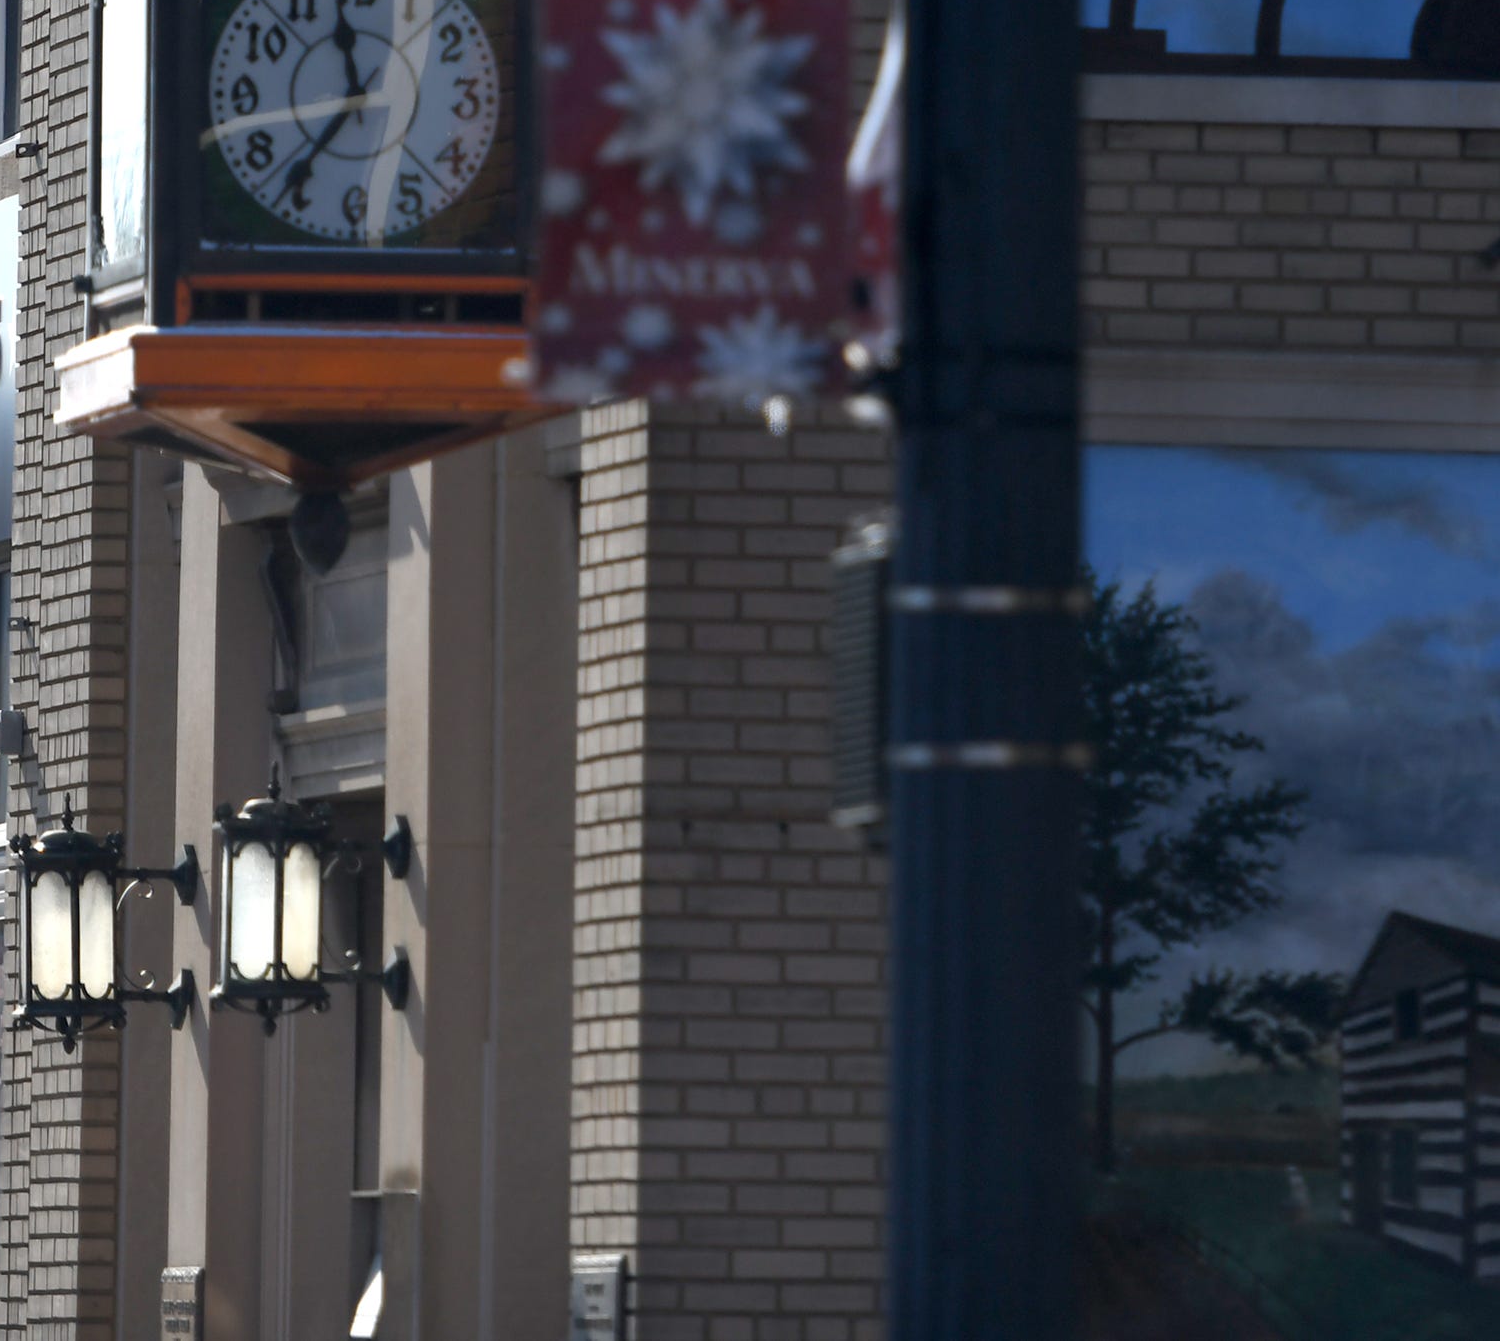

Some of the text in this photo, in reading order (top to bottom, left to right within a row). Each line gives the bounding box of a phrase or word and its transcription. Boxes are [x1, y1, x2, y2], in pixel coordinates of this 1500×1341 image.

[246, 21, 287, 65] 10
[439, 24, 463, 64] 2
[231, 74, 259, 116] 9
[452, 77, 481, 120] 3
[245, 129, 274, 172] 8
[436, 136, 470, 178] 4
[342, 184, 368, 226] 6
[396, 172, 423, 216] 5
